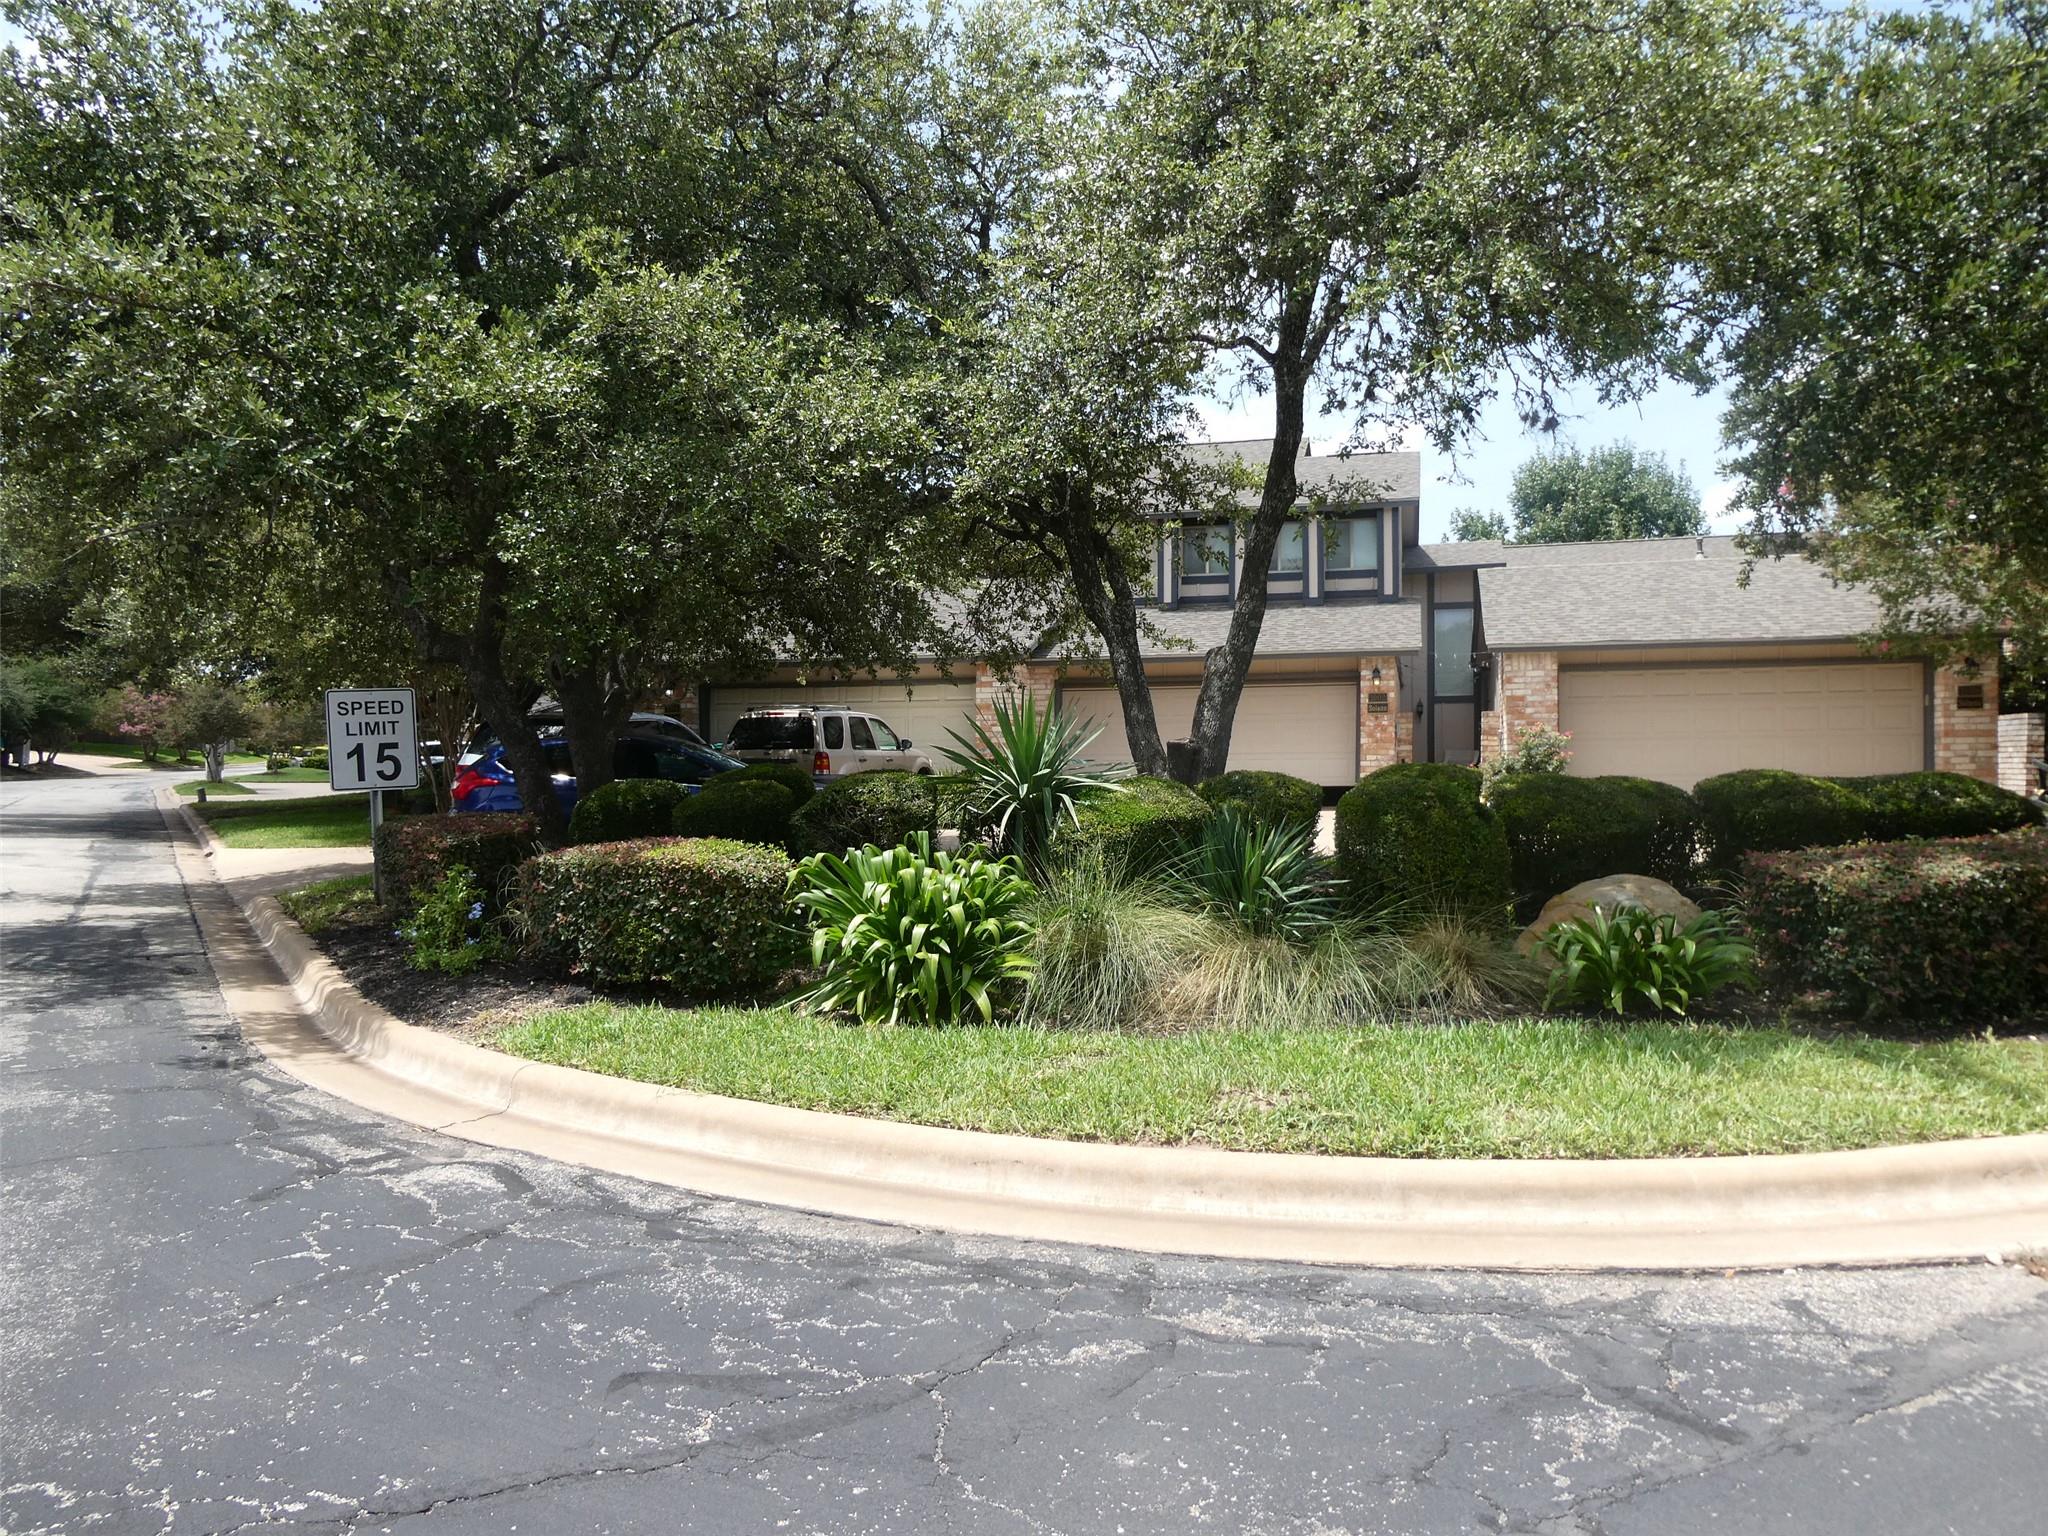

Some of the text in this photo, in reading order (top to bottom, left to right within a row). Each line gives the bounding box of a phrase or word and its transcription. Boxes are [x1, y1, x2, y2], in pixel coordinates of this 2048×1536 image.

[337, 700, 404, 716] SPEED
[345, 720, 400, 736] LIMIT
[346, 742, 402, 782] 15
